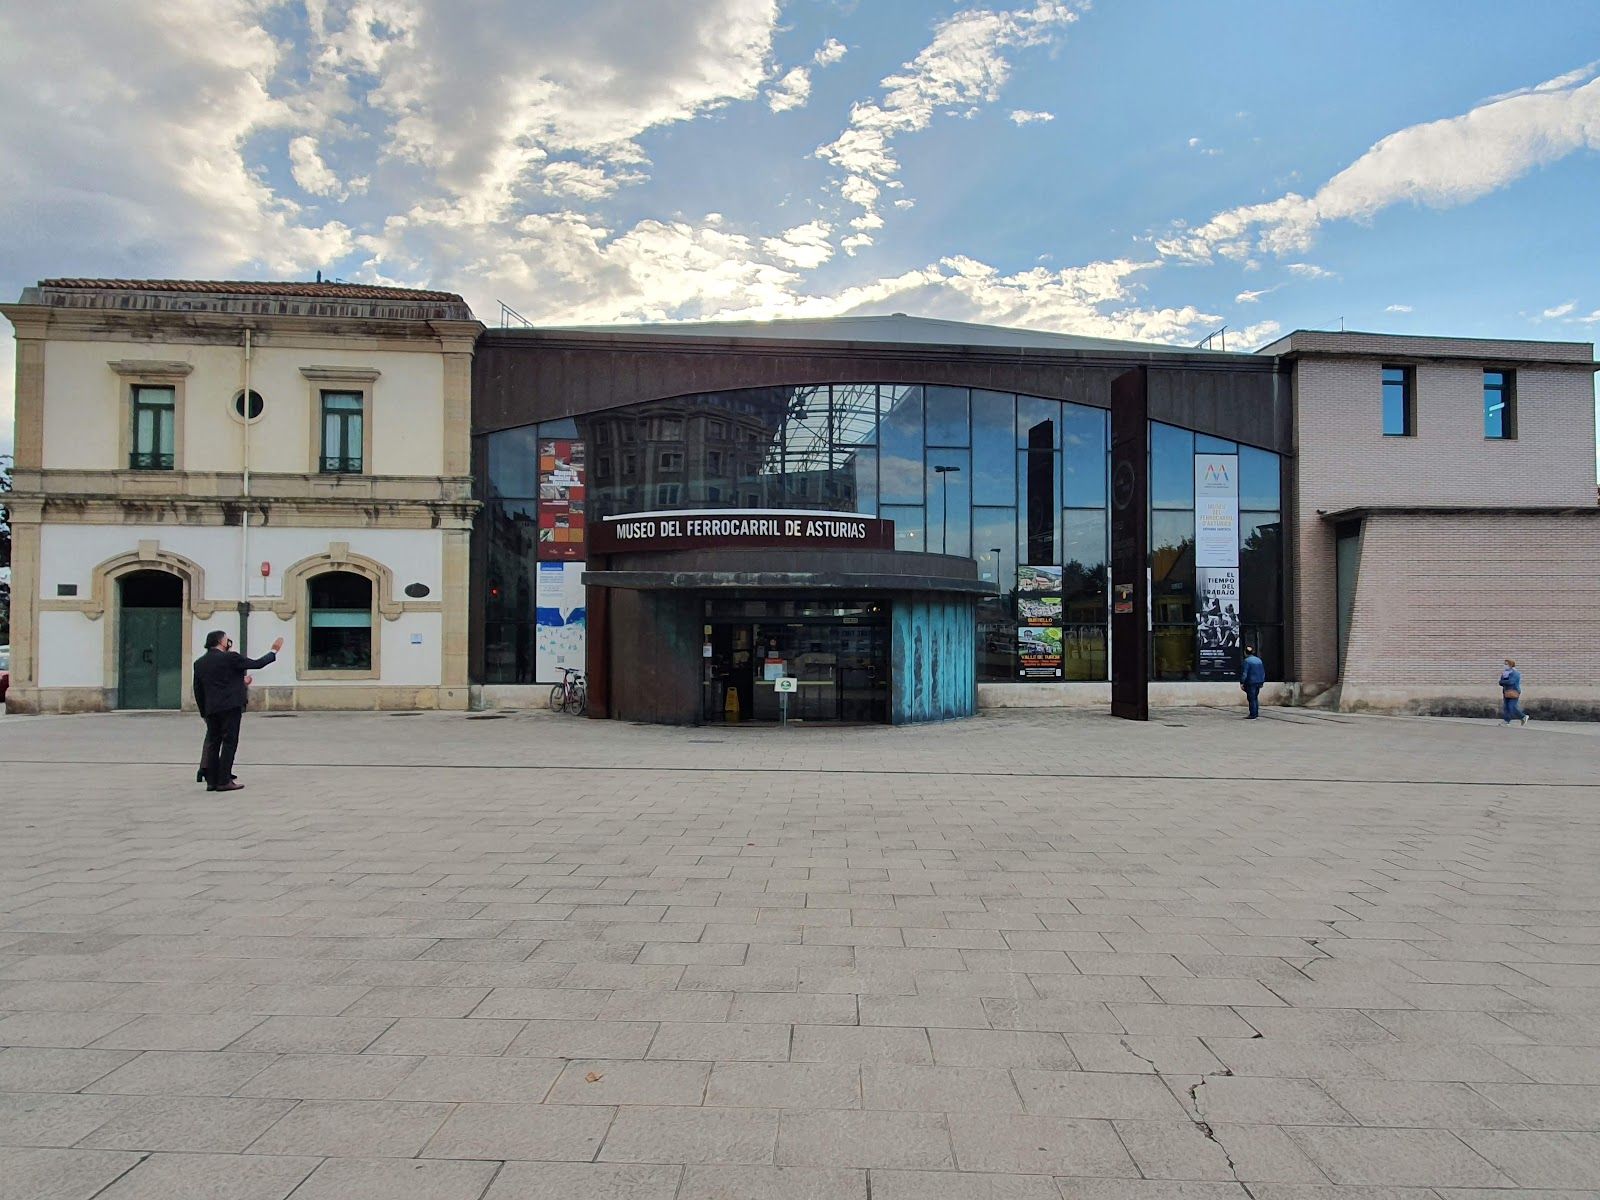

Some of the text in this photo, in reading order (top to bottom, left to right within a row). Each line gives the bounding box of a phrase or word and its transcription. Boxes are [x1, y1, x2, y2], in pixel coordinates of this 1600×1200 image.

[616, 520, 866, 539] MUSEO DEL FERROCARRIL DE ASTURIAS
